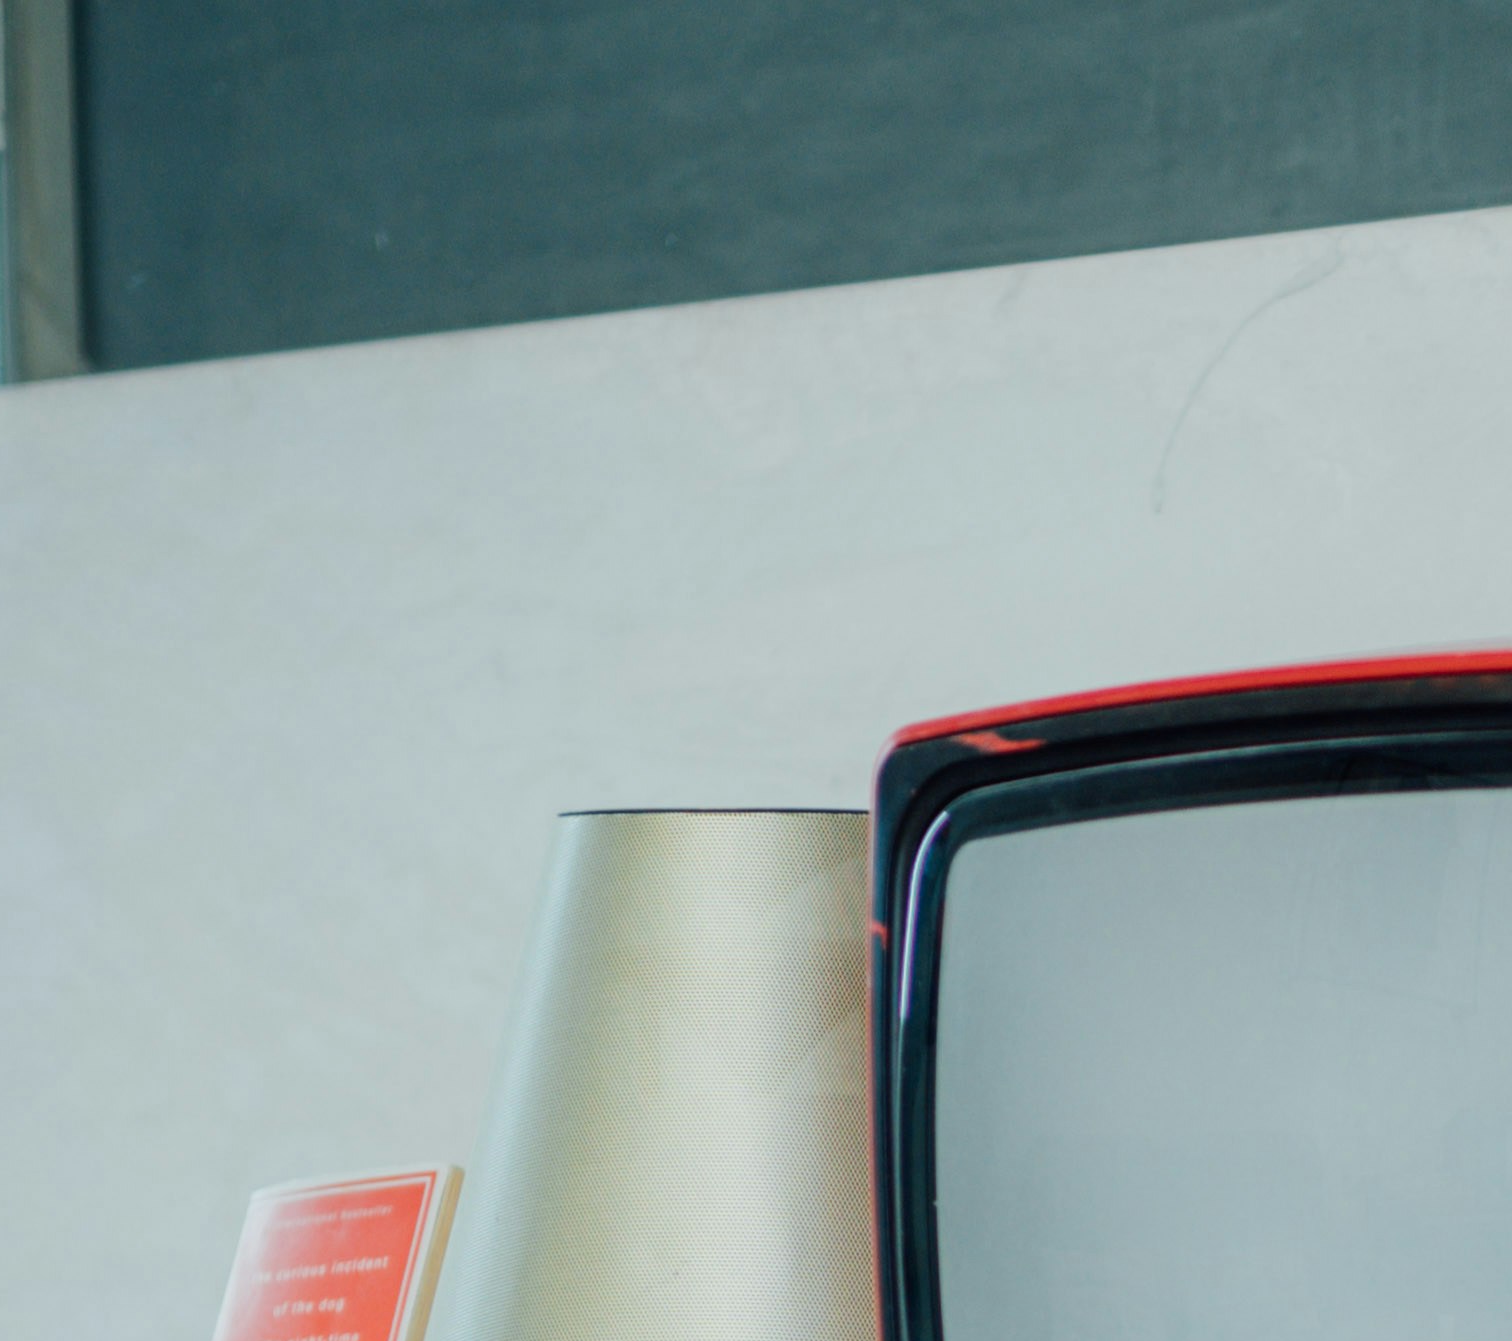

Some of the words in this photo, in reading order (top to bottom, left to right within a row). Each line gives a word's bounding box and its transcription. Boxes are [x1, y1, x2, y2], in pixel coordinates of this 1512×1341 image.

[276, 1263, 326, 1283] curious
[331, 1256, 389, 1276] incident
[273, 1300, 289, 1318] of
[291, 1297, 313, 1316] the
[318, 1296, 346, 1316] dog
